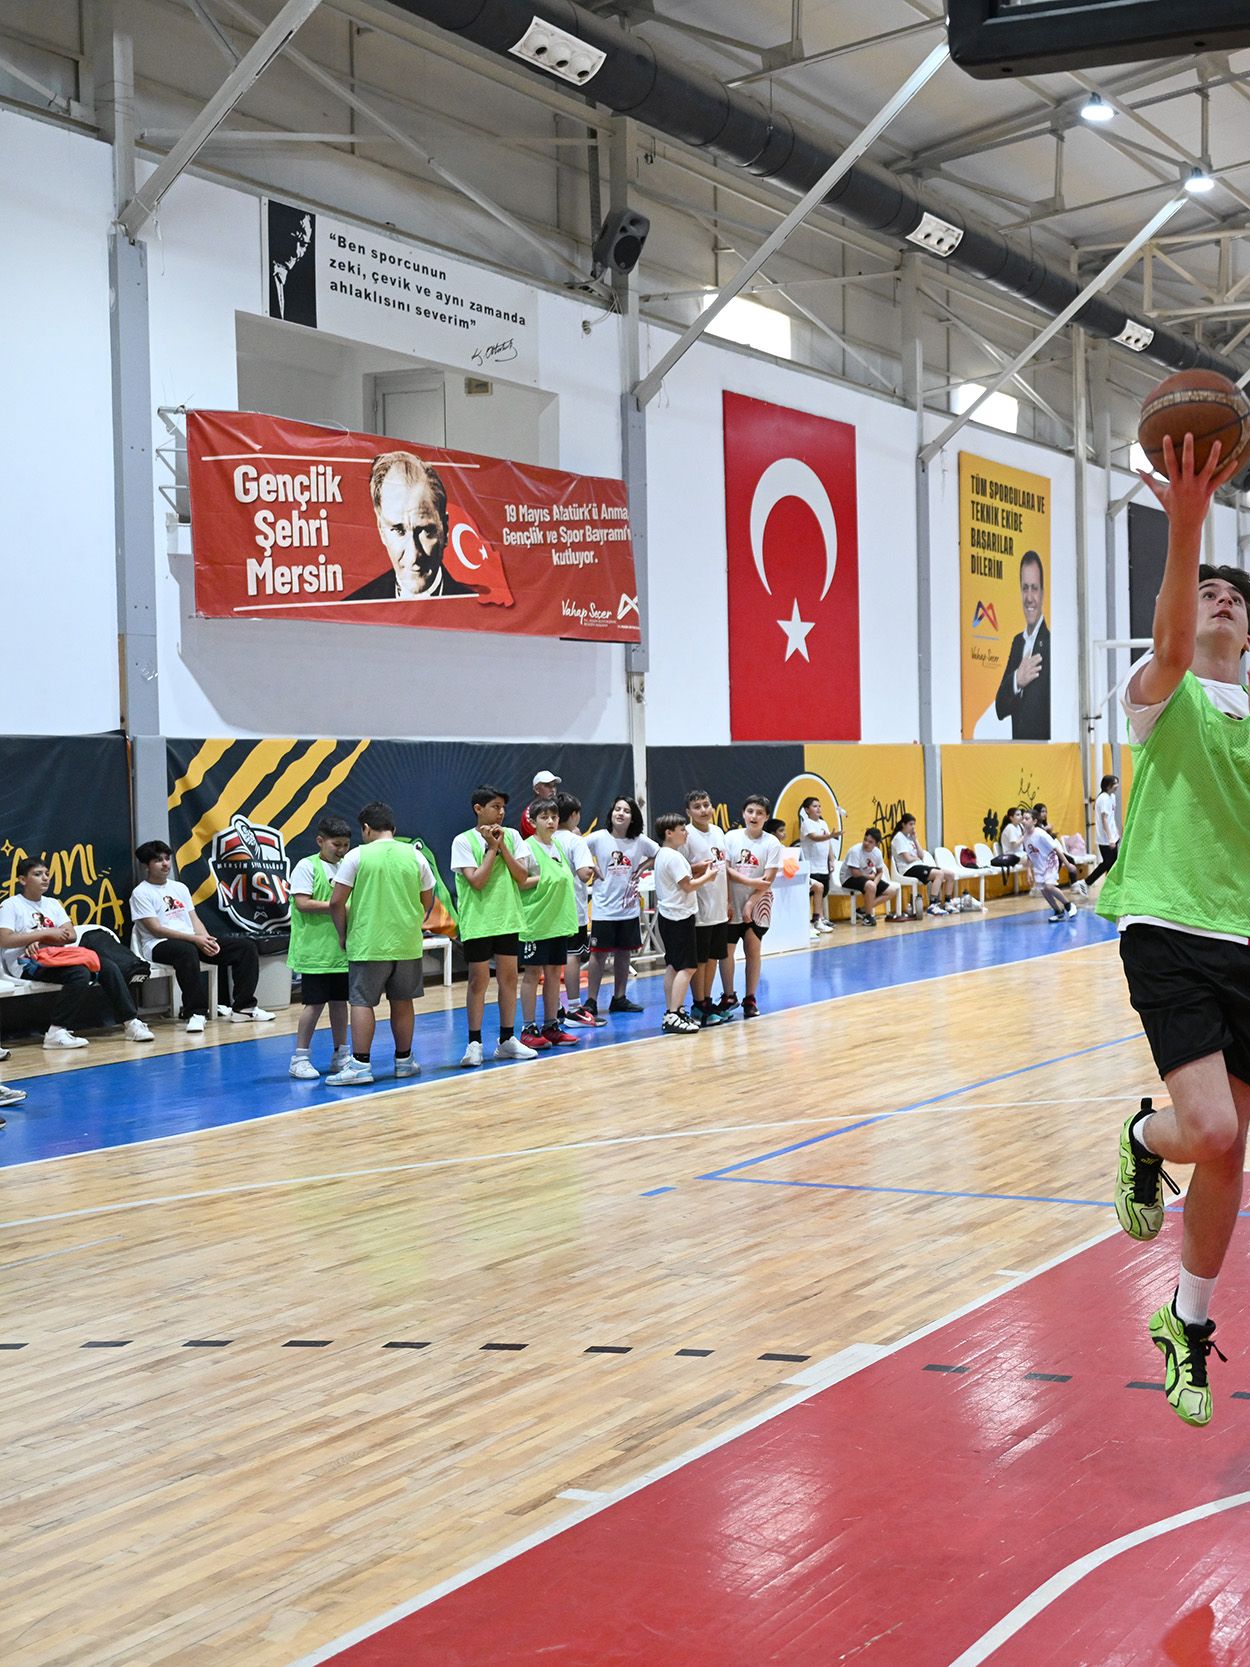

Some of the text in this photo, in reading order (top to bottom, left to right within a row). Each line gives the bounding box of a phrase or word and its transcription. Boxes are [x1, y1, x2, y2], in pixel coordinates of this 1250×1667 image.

[329, 232, 447, 280] “Ben sporcunun
[329, 258, 526, 326] zeki, çevik ve aynı zamanda
[329, 280, 476, 330] ahlaklısını severim”
[233, 464, 343, 512] Gençlik
[970, 473, 1045, 514] TÜM SPORCULARA VE
[253, 508, 329, 557] Şehri
[504, 504, 517, 522] 19
[518, 504, 551, 526] Mayıs
[970, 500, 1023, 533] TEKNİK EKİBE
[502, 527, 544, 549] Gençlik
[546, 533, 558, 544] ve
[559, 526, 584, 546] Spor
[970, 527, 1014, 556] BAŞARILAR
[246, 554, 344, 596] Mersin
[551, 548, 599, 568] kutluyor.
[970, 552, 1003, 580] DİLERİM
[561, 599, 587, 625] Vahap
